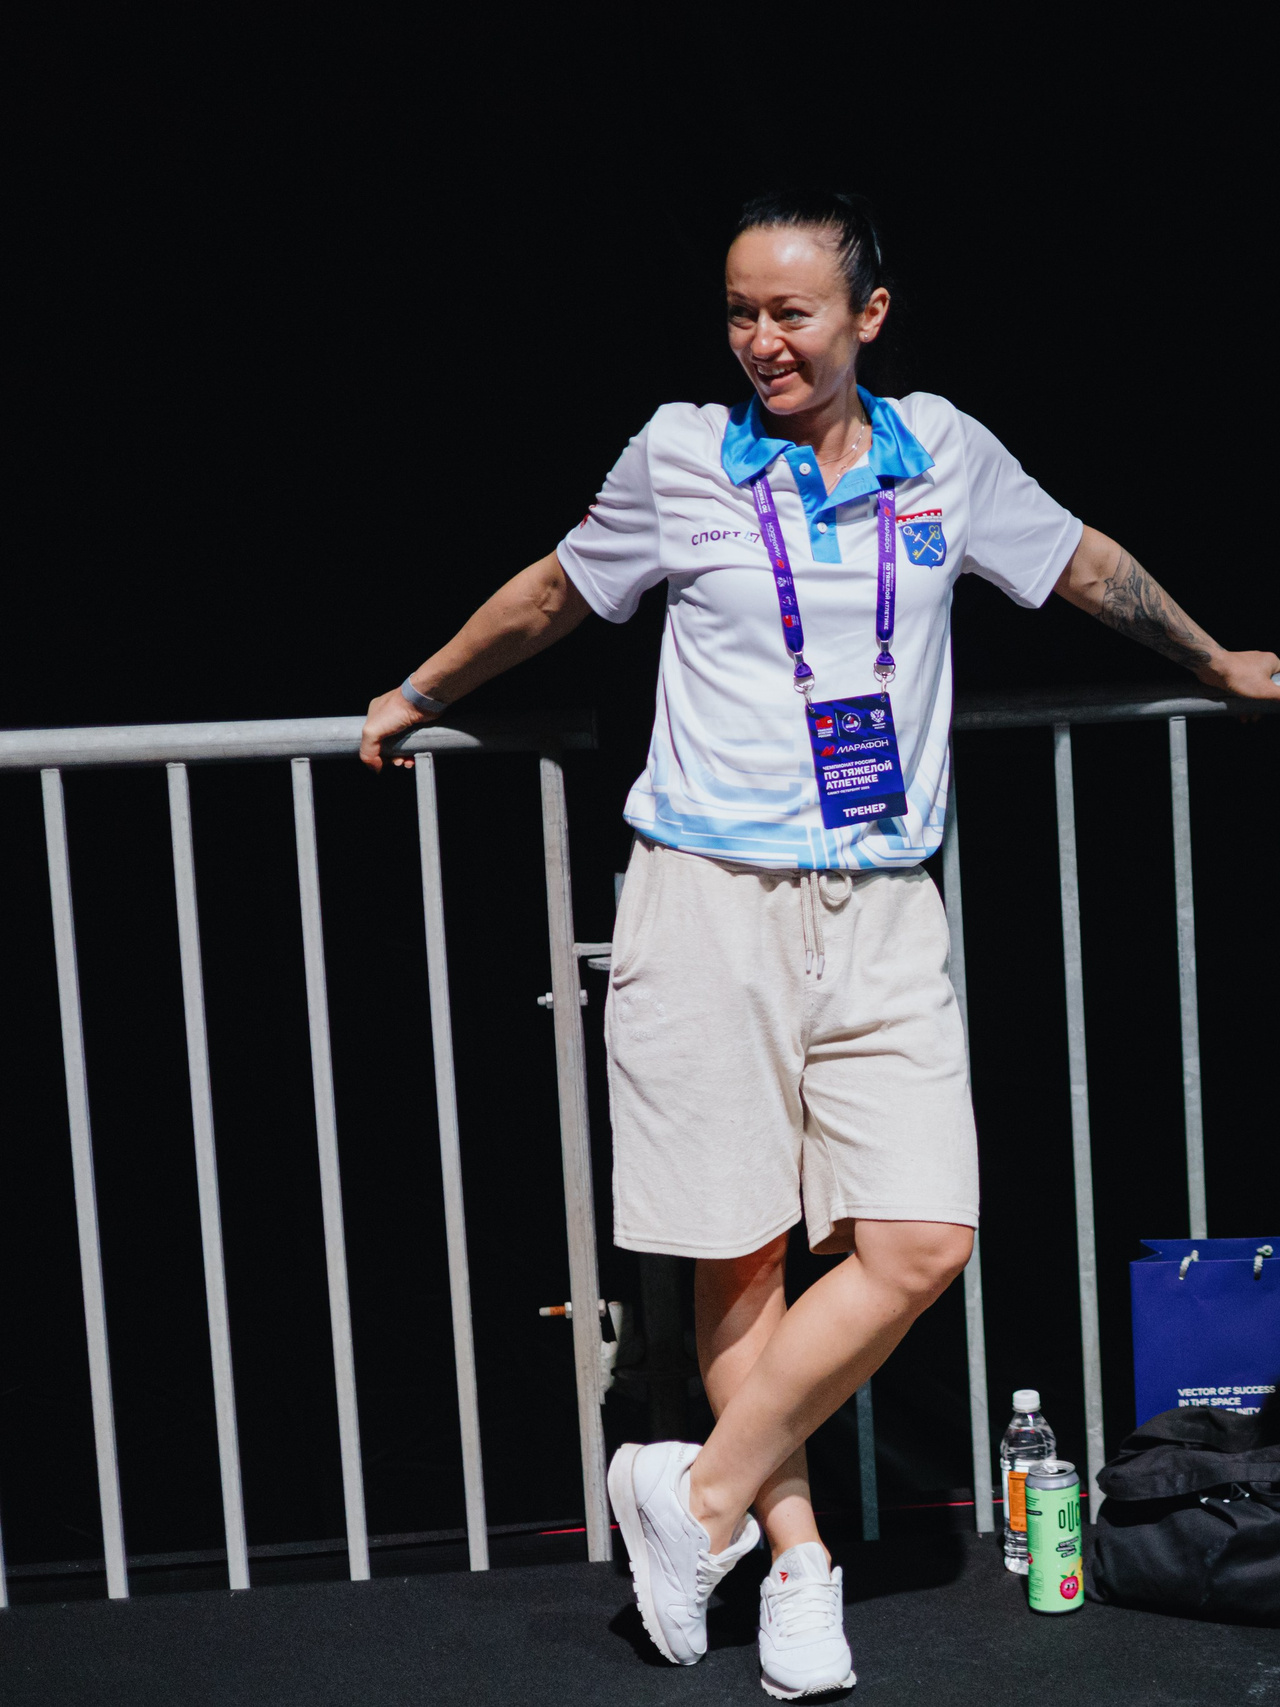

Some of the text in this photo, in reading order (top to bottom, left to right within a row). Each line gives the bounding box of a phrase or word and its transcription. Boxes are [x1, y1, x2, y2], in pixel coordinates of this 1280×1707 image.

[691, 530, 741, 546] СПОРТ
[836, 739, 889, 754] МАРАФОН
[824, 760, 893, 781] ПО ТЯЖЕЛОЙ
[826, 774, 879, 790] АТЛЕТИКЕ
[843, 803, 886, 818] ТРЕНЕР
[1177, 1385, 1276, 1397] VECTOR OF SUCCESS
[1178, 1397, 1242, 1407] IN THE SPACE
